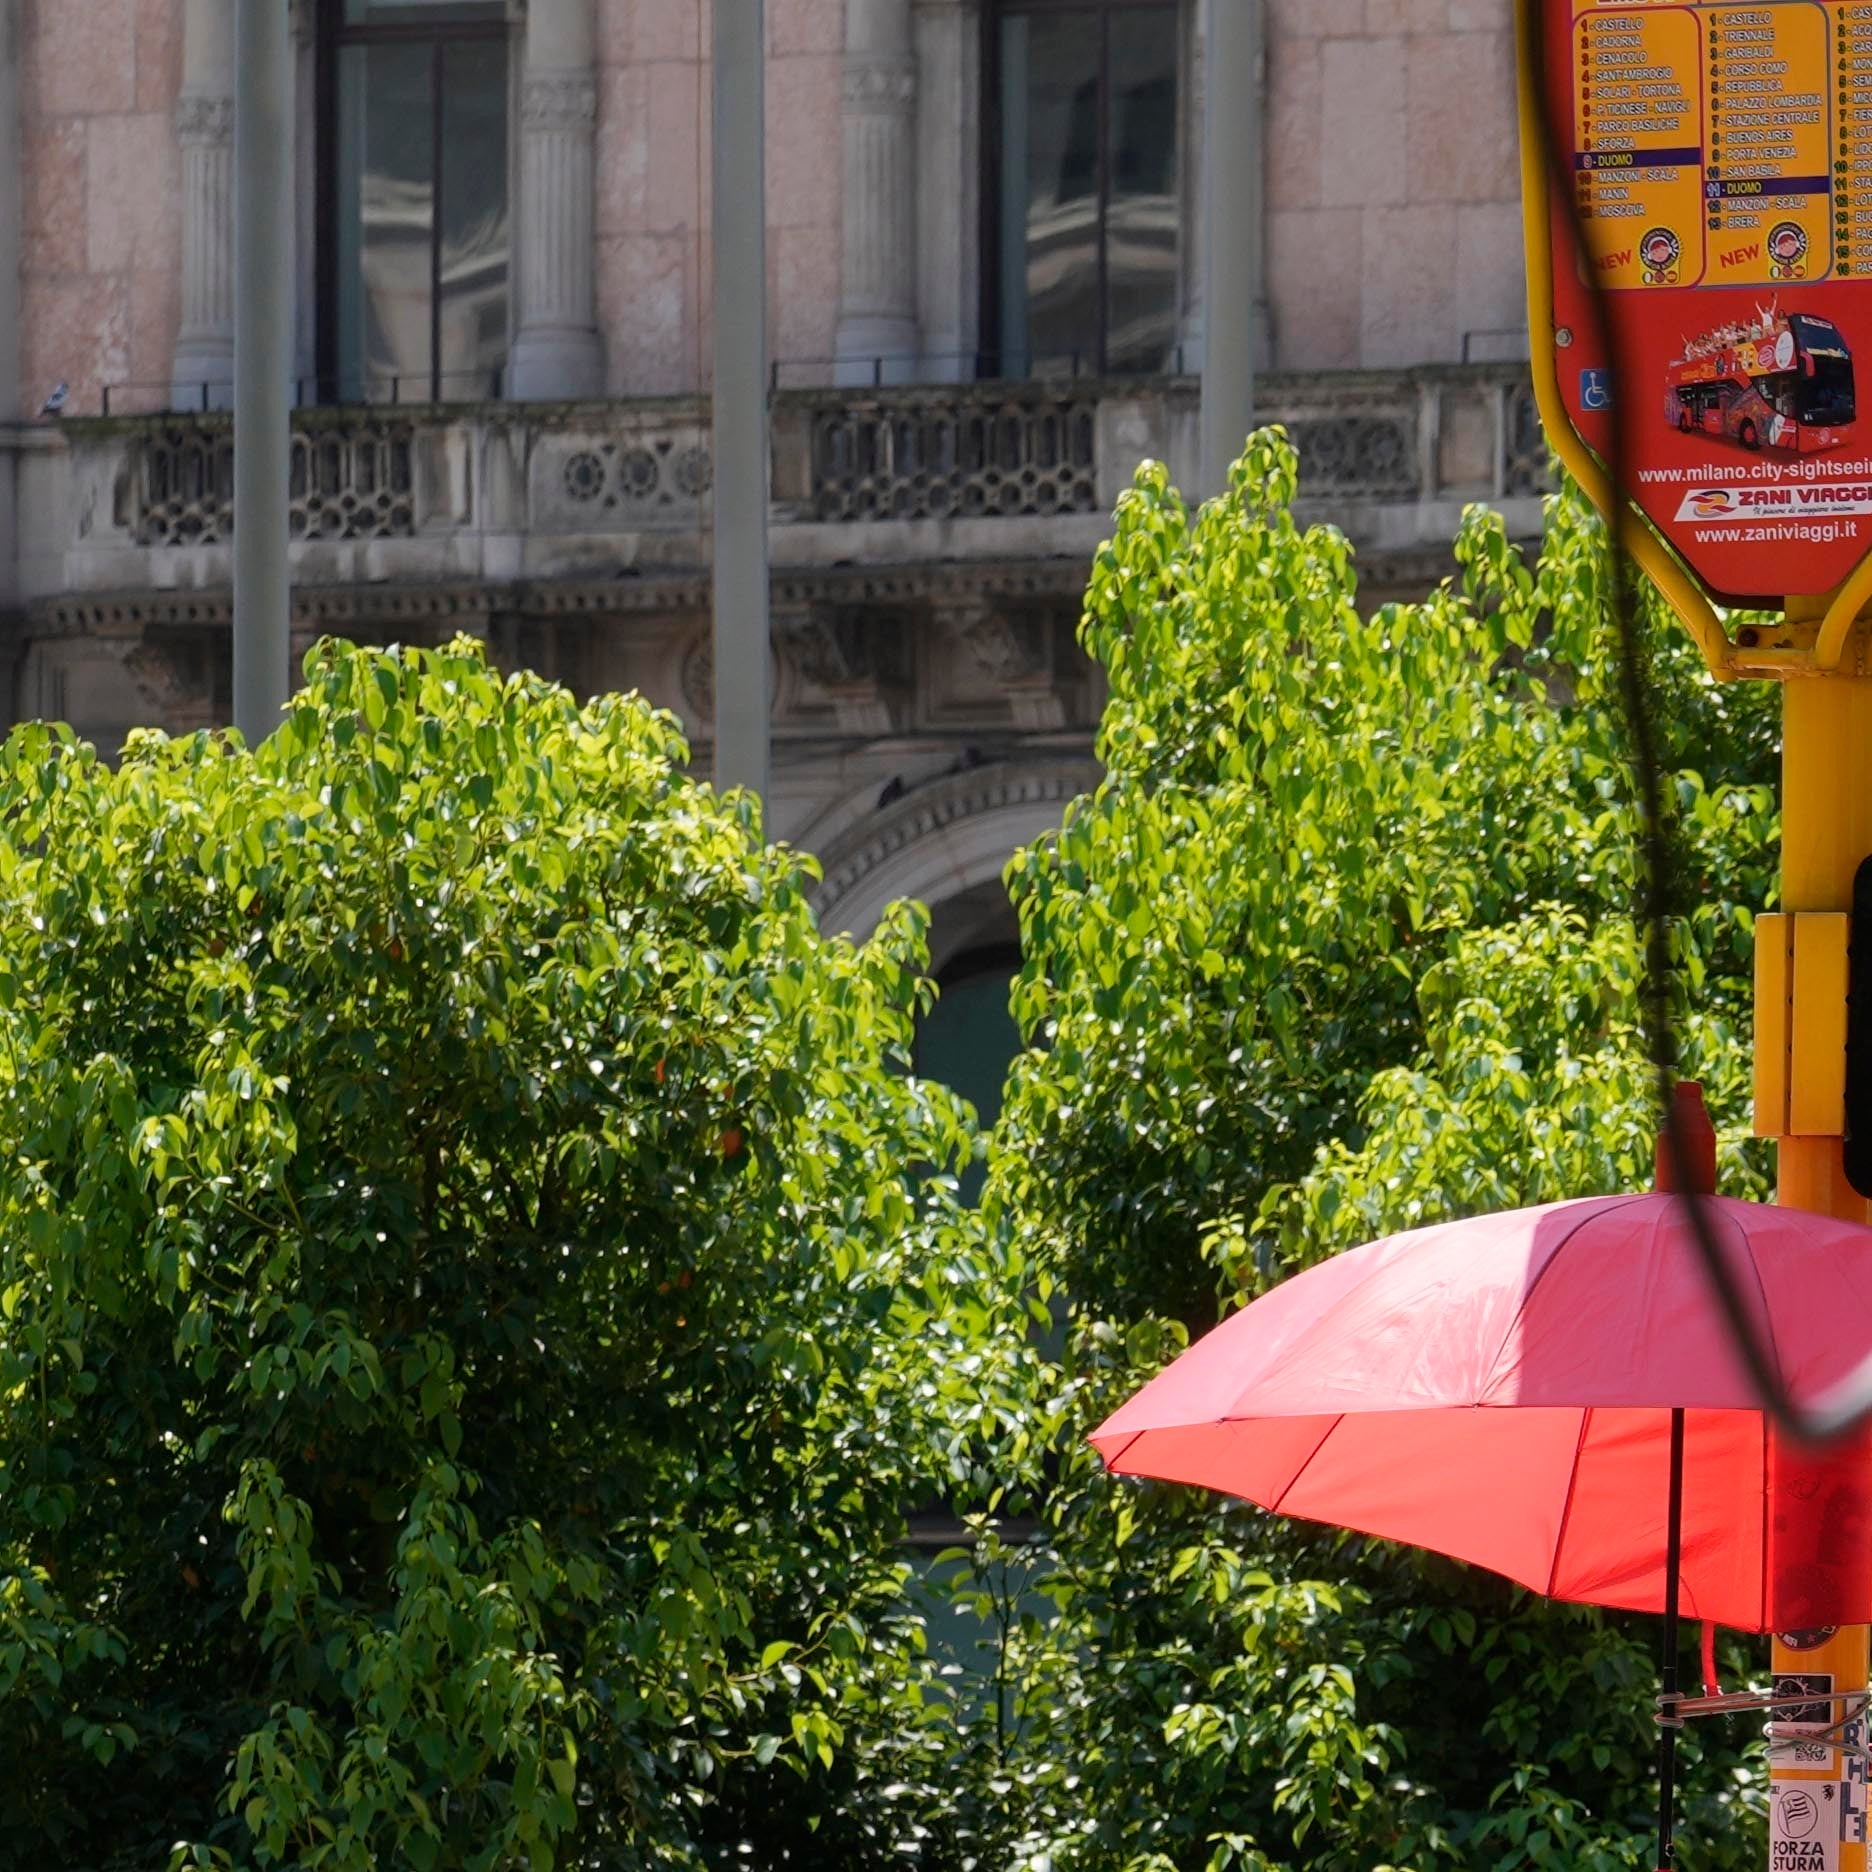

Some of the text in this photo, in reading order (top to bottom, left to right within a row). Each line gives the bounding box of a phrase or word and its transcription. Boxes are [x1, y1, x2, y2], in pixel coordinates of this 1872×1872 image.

[1724, 11, 1772, 25] CASTELLO
[1595, 18, 1644, 32] CASTELLO
[1596, 35, 1641, 47] CADORNA
[1724, 29, 1775, 41] TRIENNALE
[1596, 52, 1647, 65] CENACOLO
[1725, 64, 1758, 76] CORSO
[1760, 62, 1788, 74] COMO
[1638, 84, 1682, 96] TORTONA
[1772, 112, 1819, 124] CENTRALE
[1598, 121, 1629, 132] PARCO
[1767, 129, 1792, 141] AIRES
[1598, 154, 1633, 166] DUOMO
[1727, 150, 1756, 161] PORTA
[1648, 169, 1679, 181] SCALA
[1727, 166, 1745, 178] SAN
[1727, 182, 1761, 194] DUOMO
[1776, 197, 1806, 209] SCALA
[1728, 216, 1759, 228] BRERA
[1720, 244, 1759, 268] NEW
[1739, 490, 1791, 506] ZANI
[1695, 521, 1857, 542] www.zaniviaggi.it
[1774, 1841, 1824, 1855] FORZA
[1774, 1857, 1824, 1871] STURM
